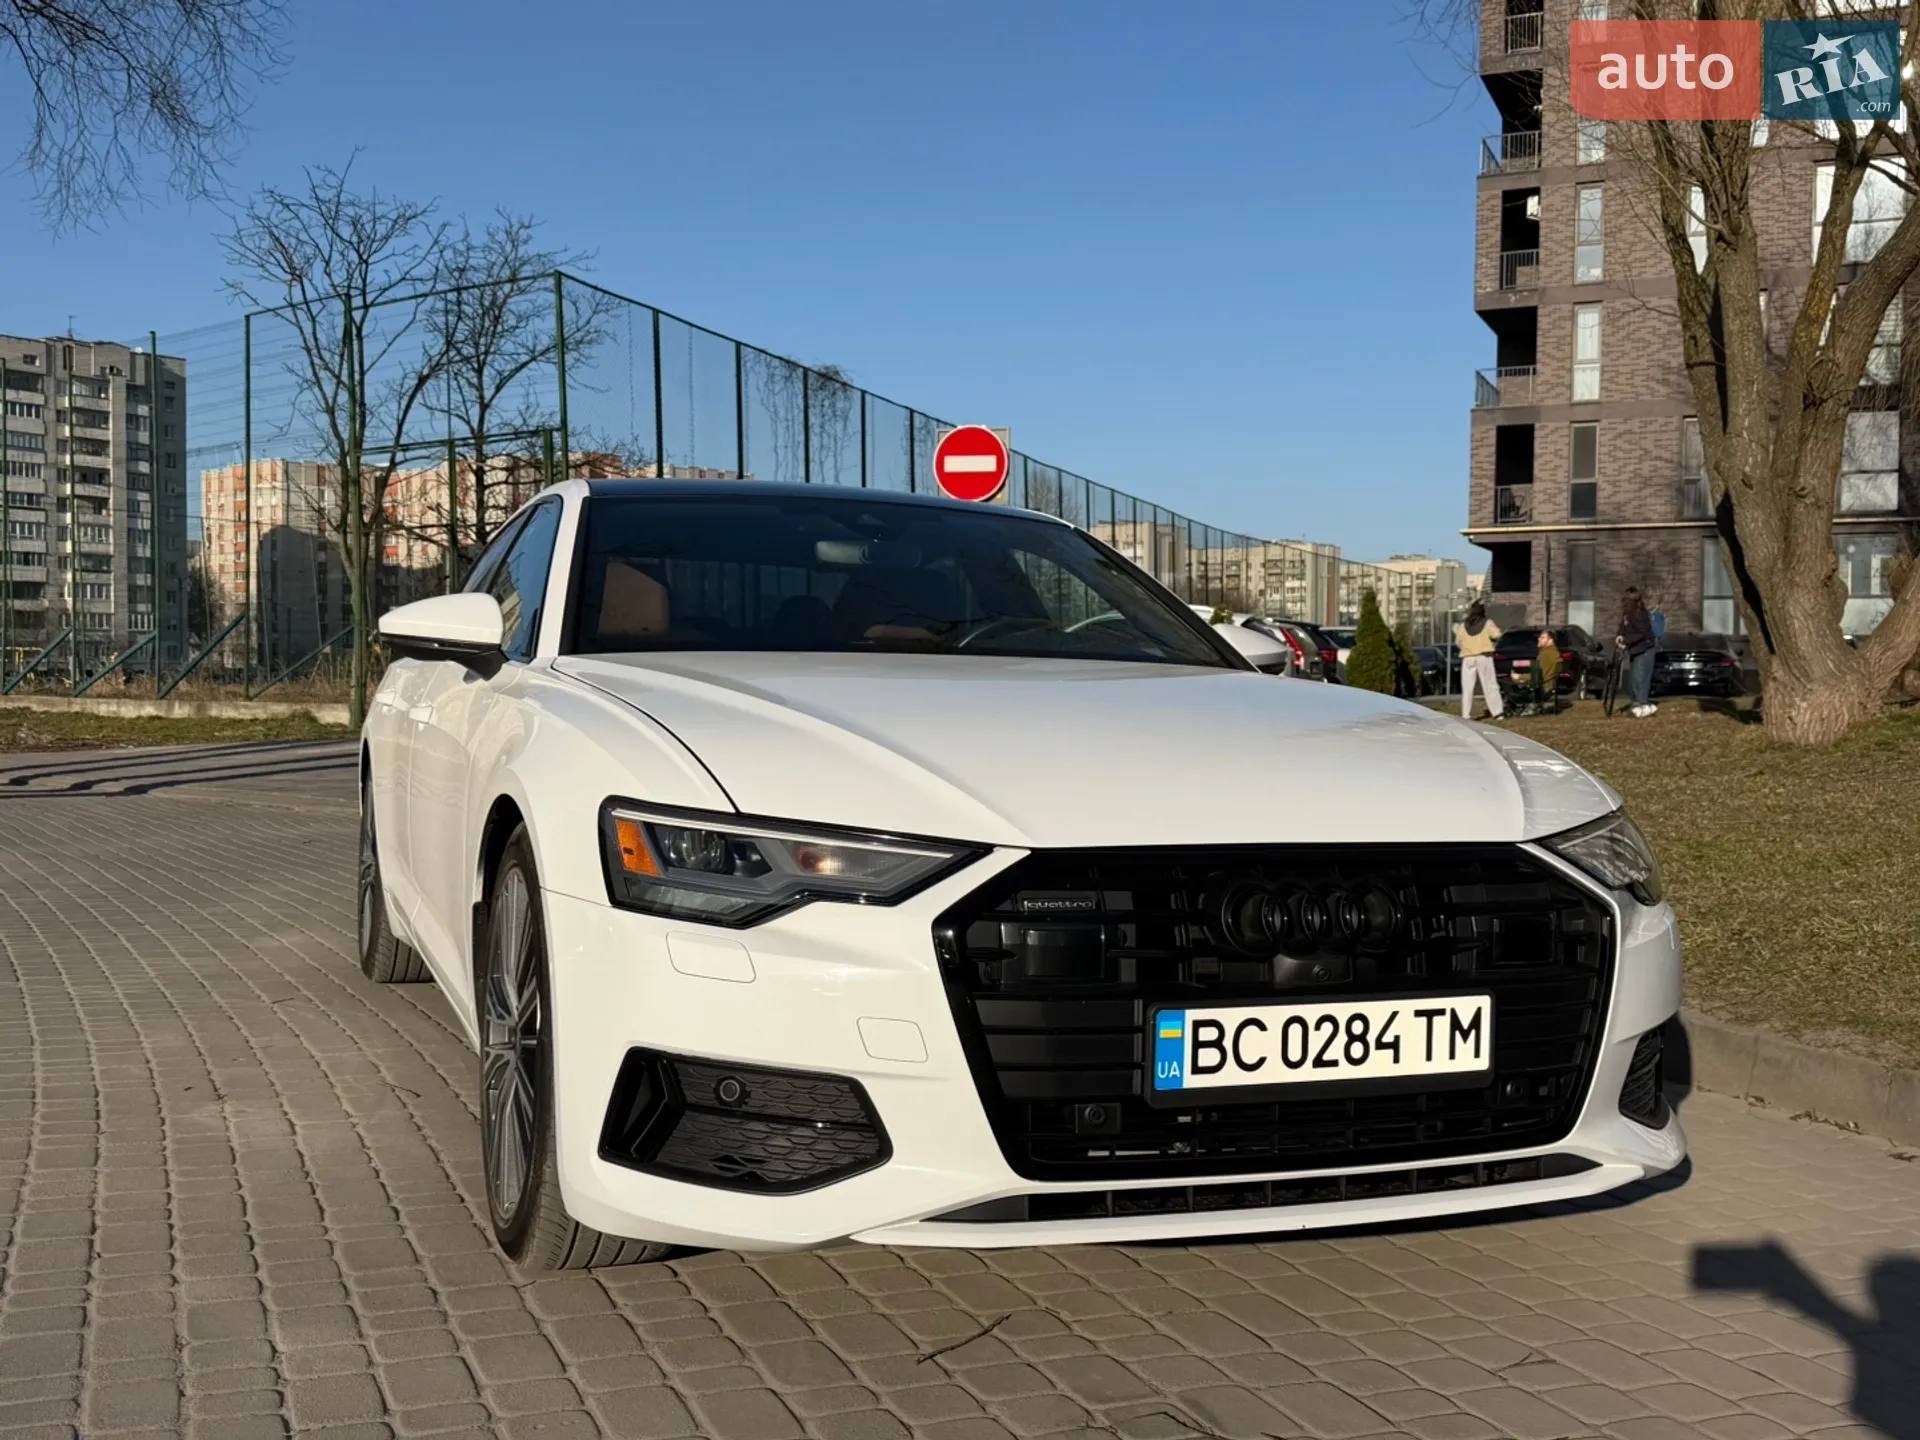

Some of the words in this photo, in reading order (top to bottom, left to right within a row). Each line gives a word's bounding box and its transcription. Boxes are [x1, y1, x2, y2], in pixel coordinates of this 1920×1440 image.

[1191, 1018, 1268, 1075] BC
[1281, 1010, 1401, 1070] 0284
[1414, 1006, 1482, 1062] TM
[1157, 1061, 1180, 1079] UA
